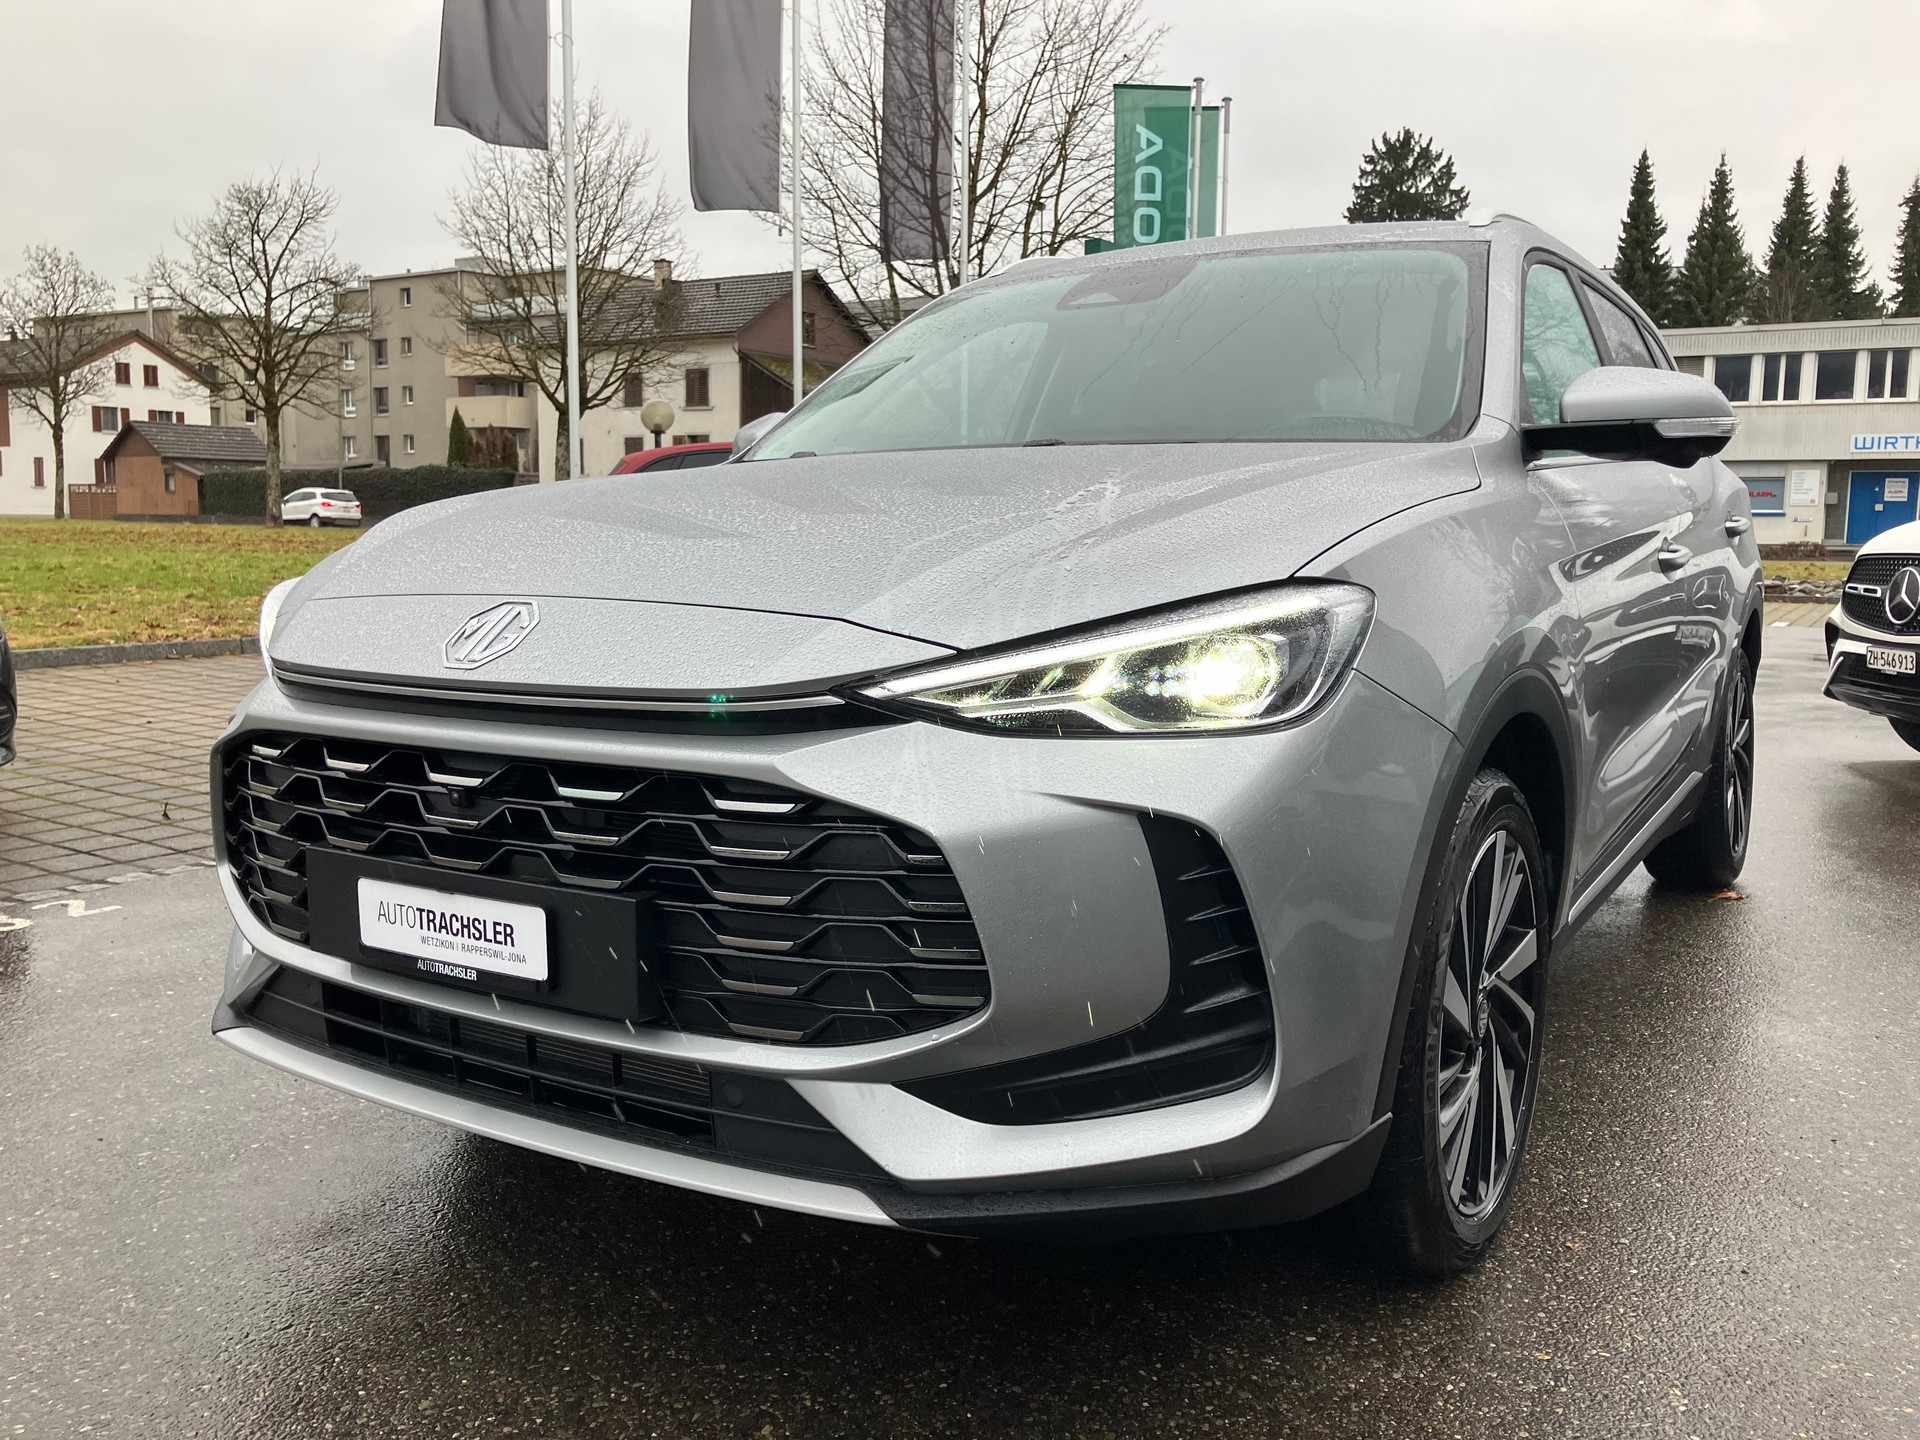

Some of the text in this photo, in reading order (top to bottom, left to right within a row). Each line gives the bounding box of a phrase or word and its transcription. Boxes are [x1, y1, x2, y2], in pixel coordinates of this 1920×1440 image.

[446, 603, 533, 663] MG
[377, 900, 516, 948] AUTOTRACHSLER
[420, 934, 455, 952] WETZIKON
[461, 942, 528, 965] RAPPERSWIL-JONA
[417, 959, 477, 981] AUTOTRACHSLER
